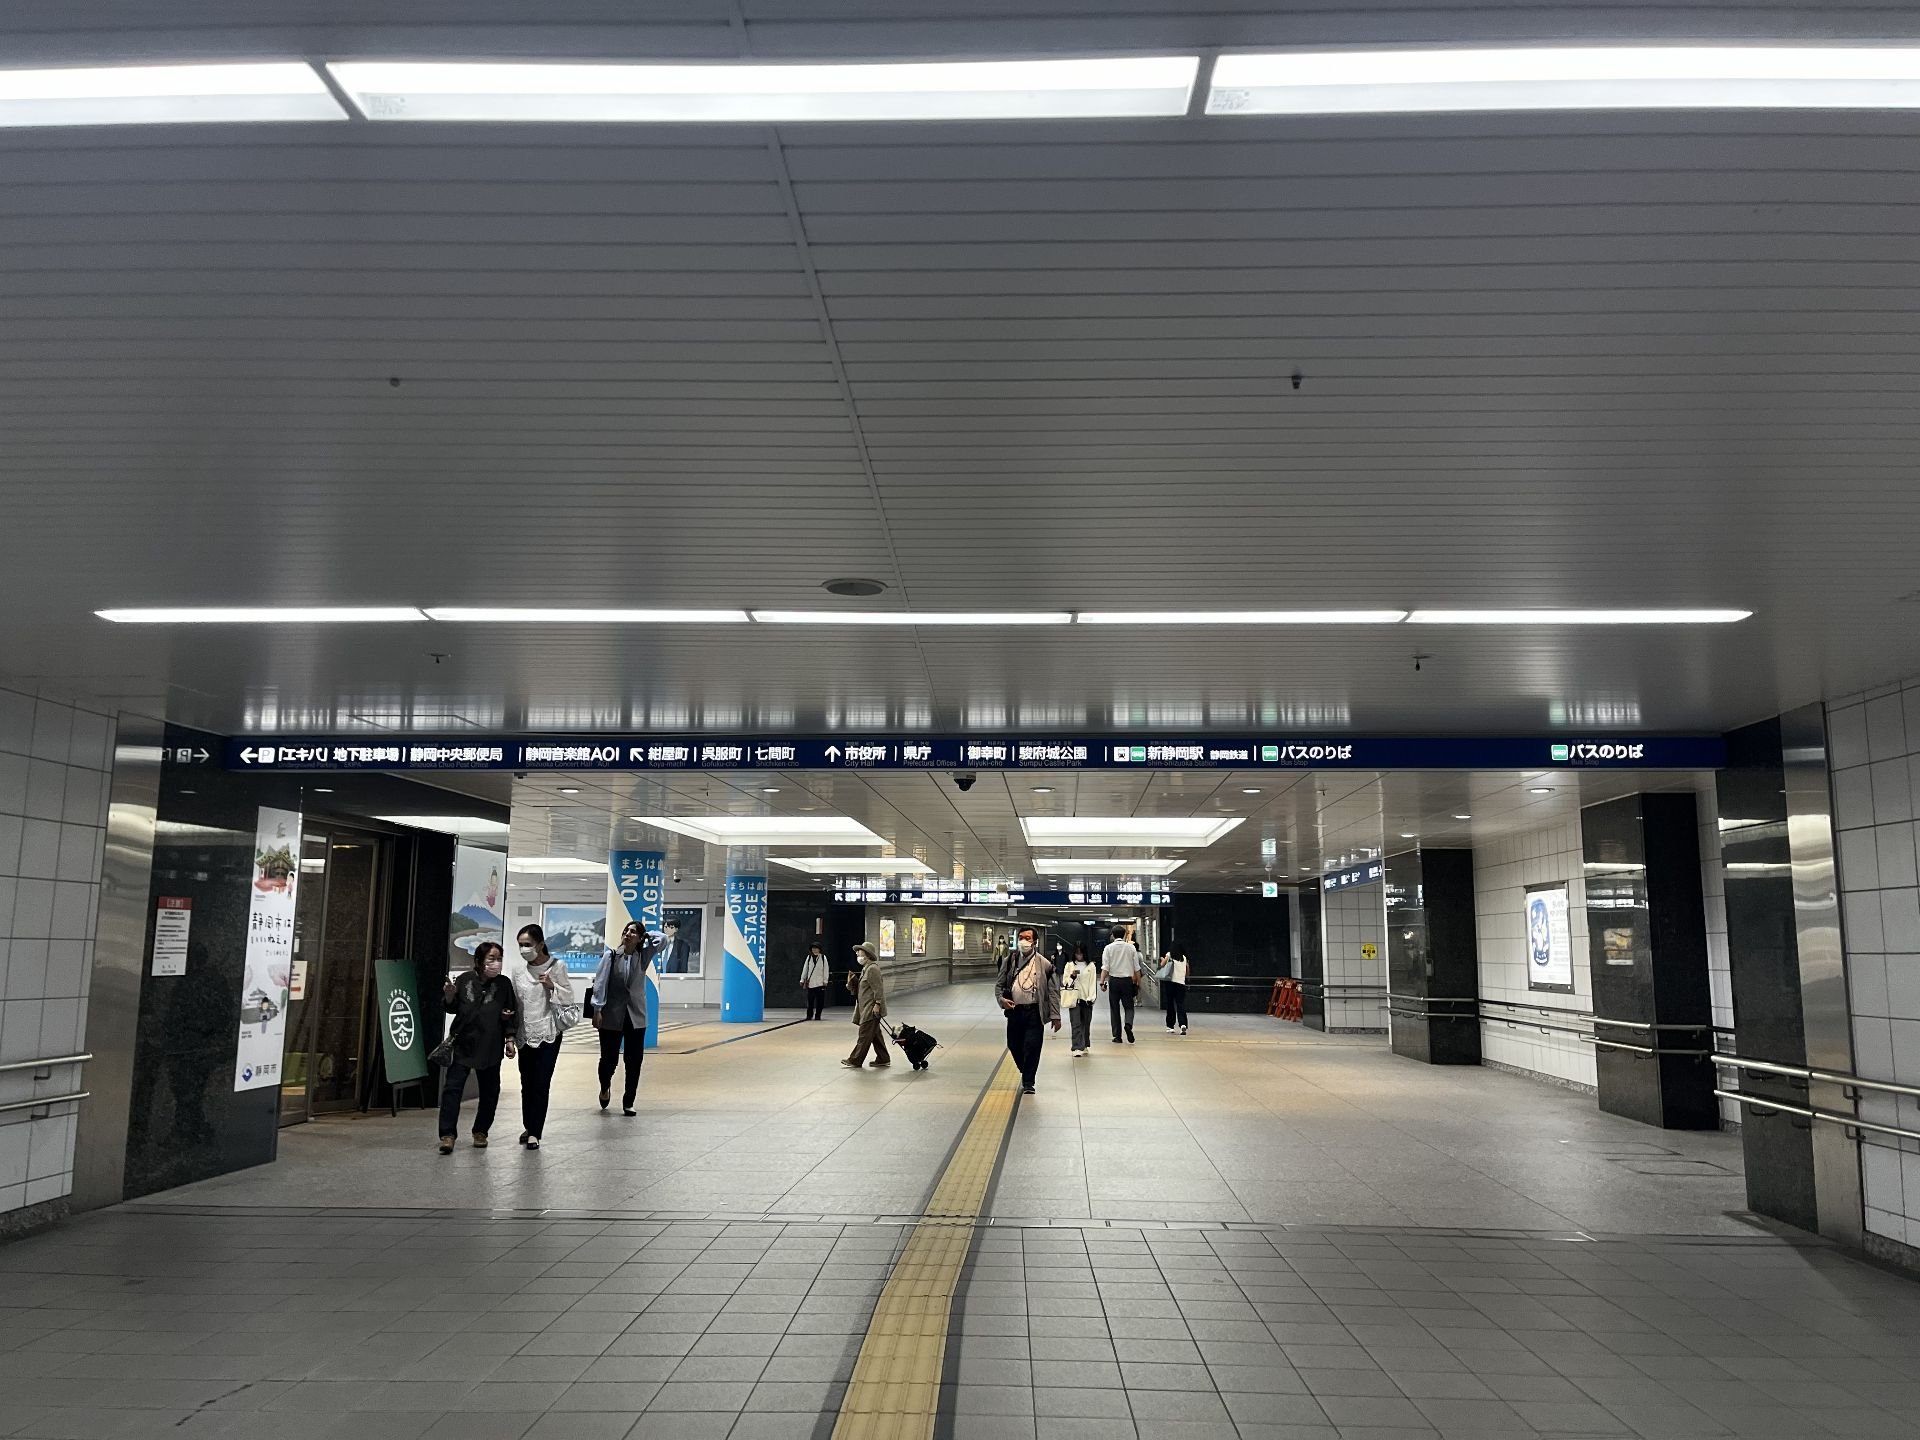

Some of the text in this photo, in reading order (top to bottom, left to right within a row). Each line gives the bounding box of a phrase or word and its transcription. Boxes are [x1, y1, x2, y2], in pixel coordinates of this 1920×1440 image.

[332, 746, 400, 762] 地下駐車場
[410, 746, 503, 762] 静岡中央郵便局
[525, 746, 620, 762] 静岡音楽館AOI
[647, 746, 690, 762] 紺屋町
[701, 746, 743, 761] 呉服町
[754, 746, 796, 761] 七間町
[844, 745, 887, 761] 市役所
[903, 745, 932, 760] 県庁
[967, 745, 1007, 760] 御幸町
[1018, 745, 1088, 760] 駿府城公園
[1147, 745, 1204, 760] 新静岡駅
[1280, 744, 1353, 760] バスのりば
[1569, 743, 1644, 759] バスのりば
[844, 759, 875, 768] City Hall
[967, 759, 1003, 768] Miyuki-cho
[1018, 759, 1082, 768] Sumpu Castle Park
[621, 874, 639, 902] ON
[730, 894, 742, 914] ON
[743, 893, 759, 945] STAGE
[758, 895, 768, 978] SHIZUOKA
